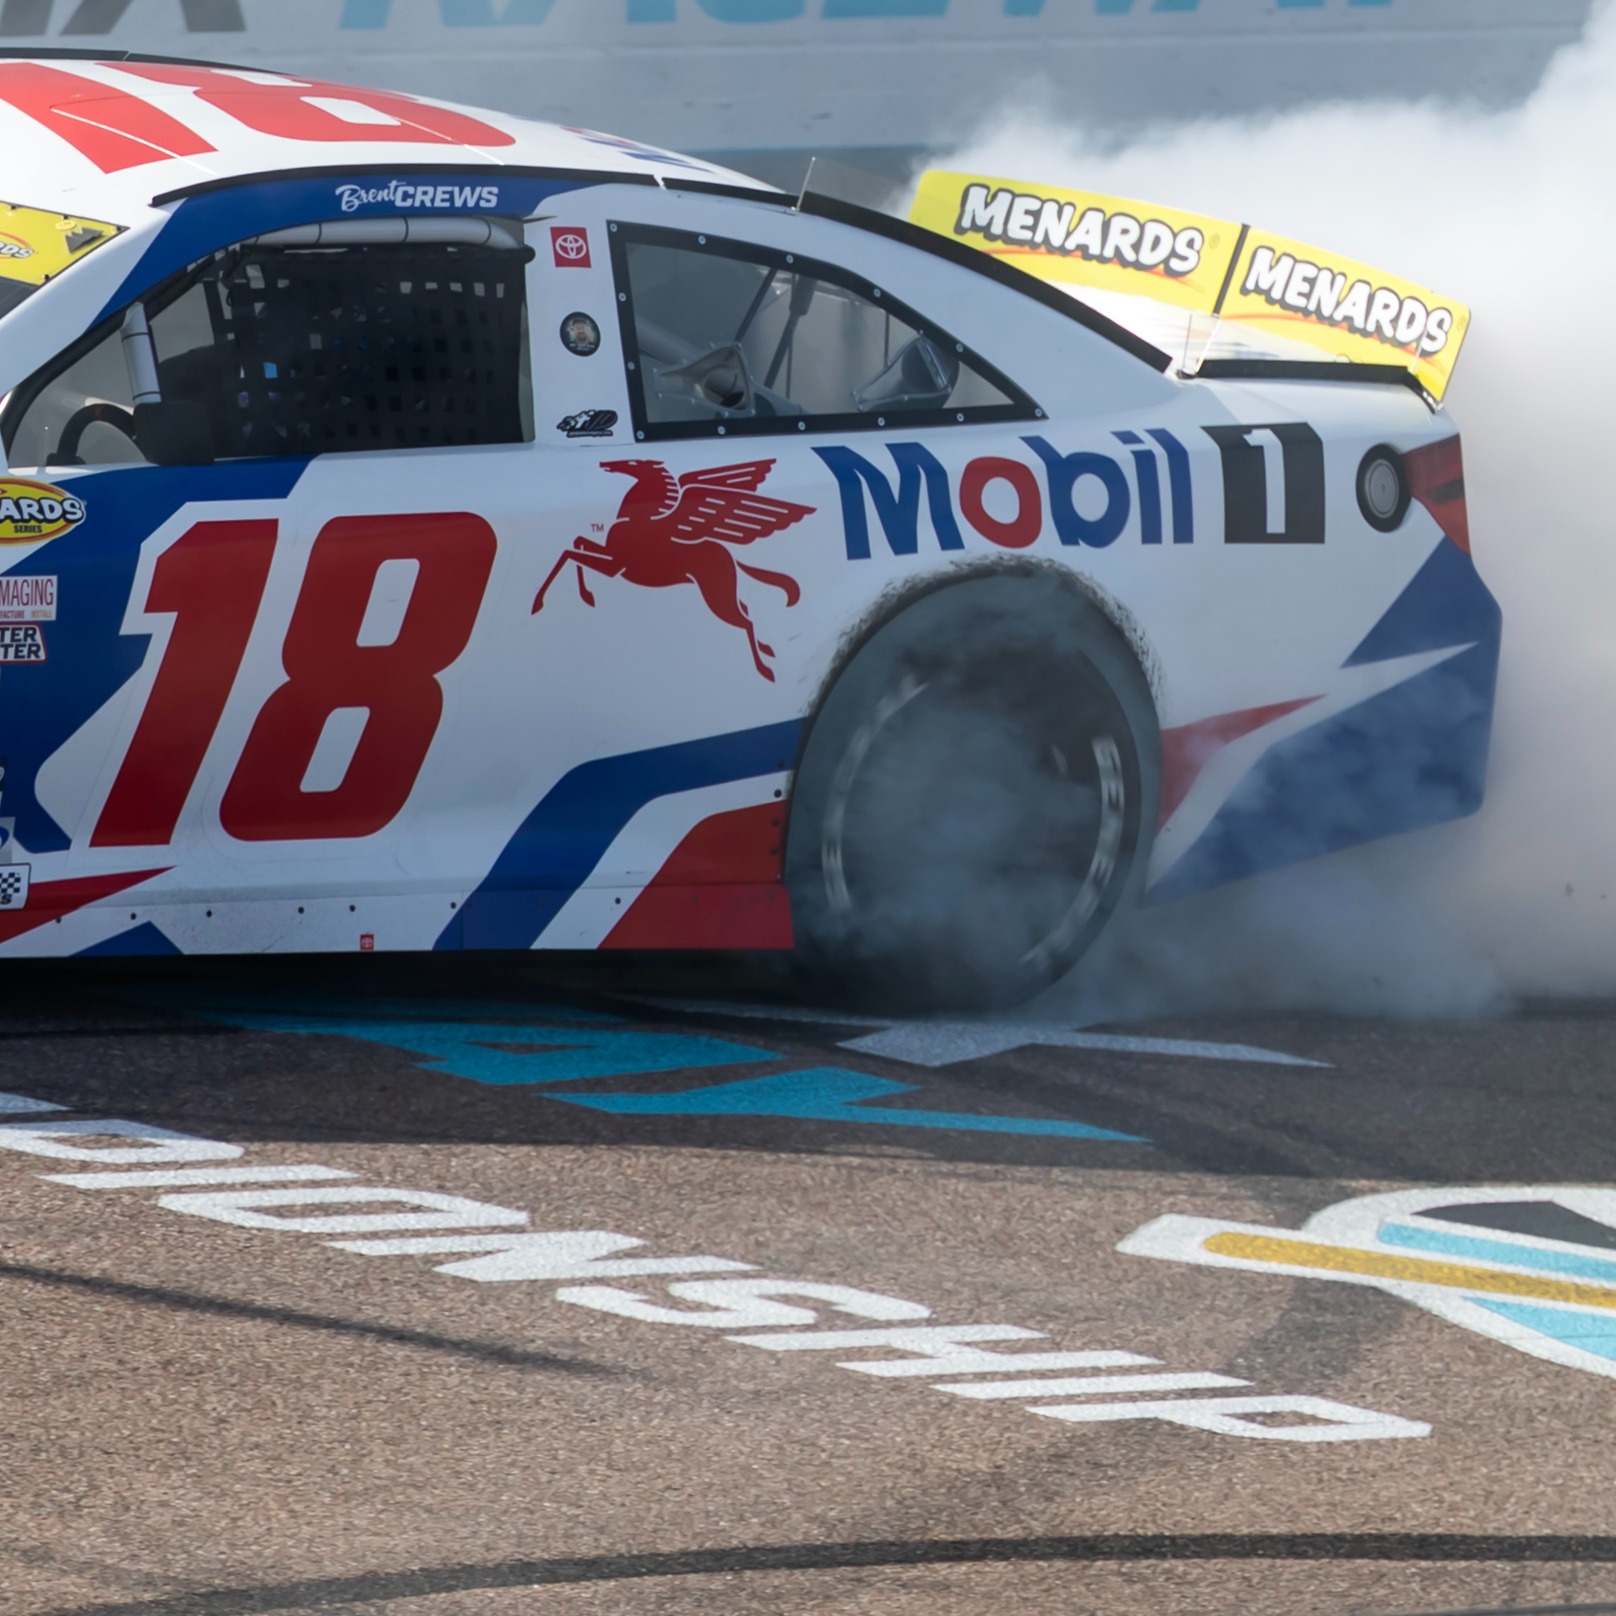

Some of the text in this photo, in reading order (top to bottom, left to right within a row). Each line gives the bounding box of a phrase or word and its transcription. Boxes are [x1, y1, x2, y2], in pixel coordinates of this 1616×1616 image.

[335, 181, 499, 212] Brent CREWS
[954, 183, 1205, 279] MENARDS
[1241, 246, 1454, 358] MENARDS
[14, 525, 43, 533] SERIES
[591, 524, 604, 532] TM
[811, 427, 1195, 561] Mobil
[89, 511, 498, 848] 18
